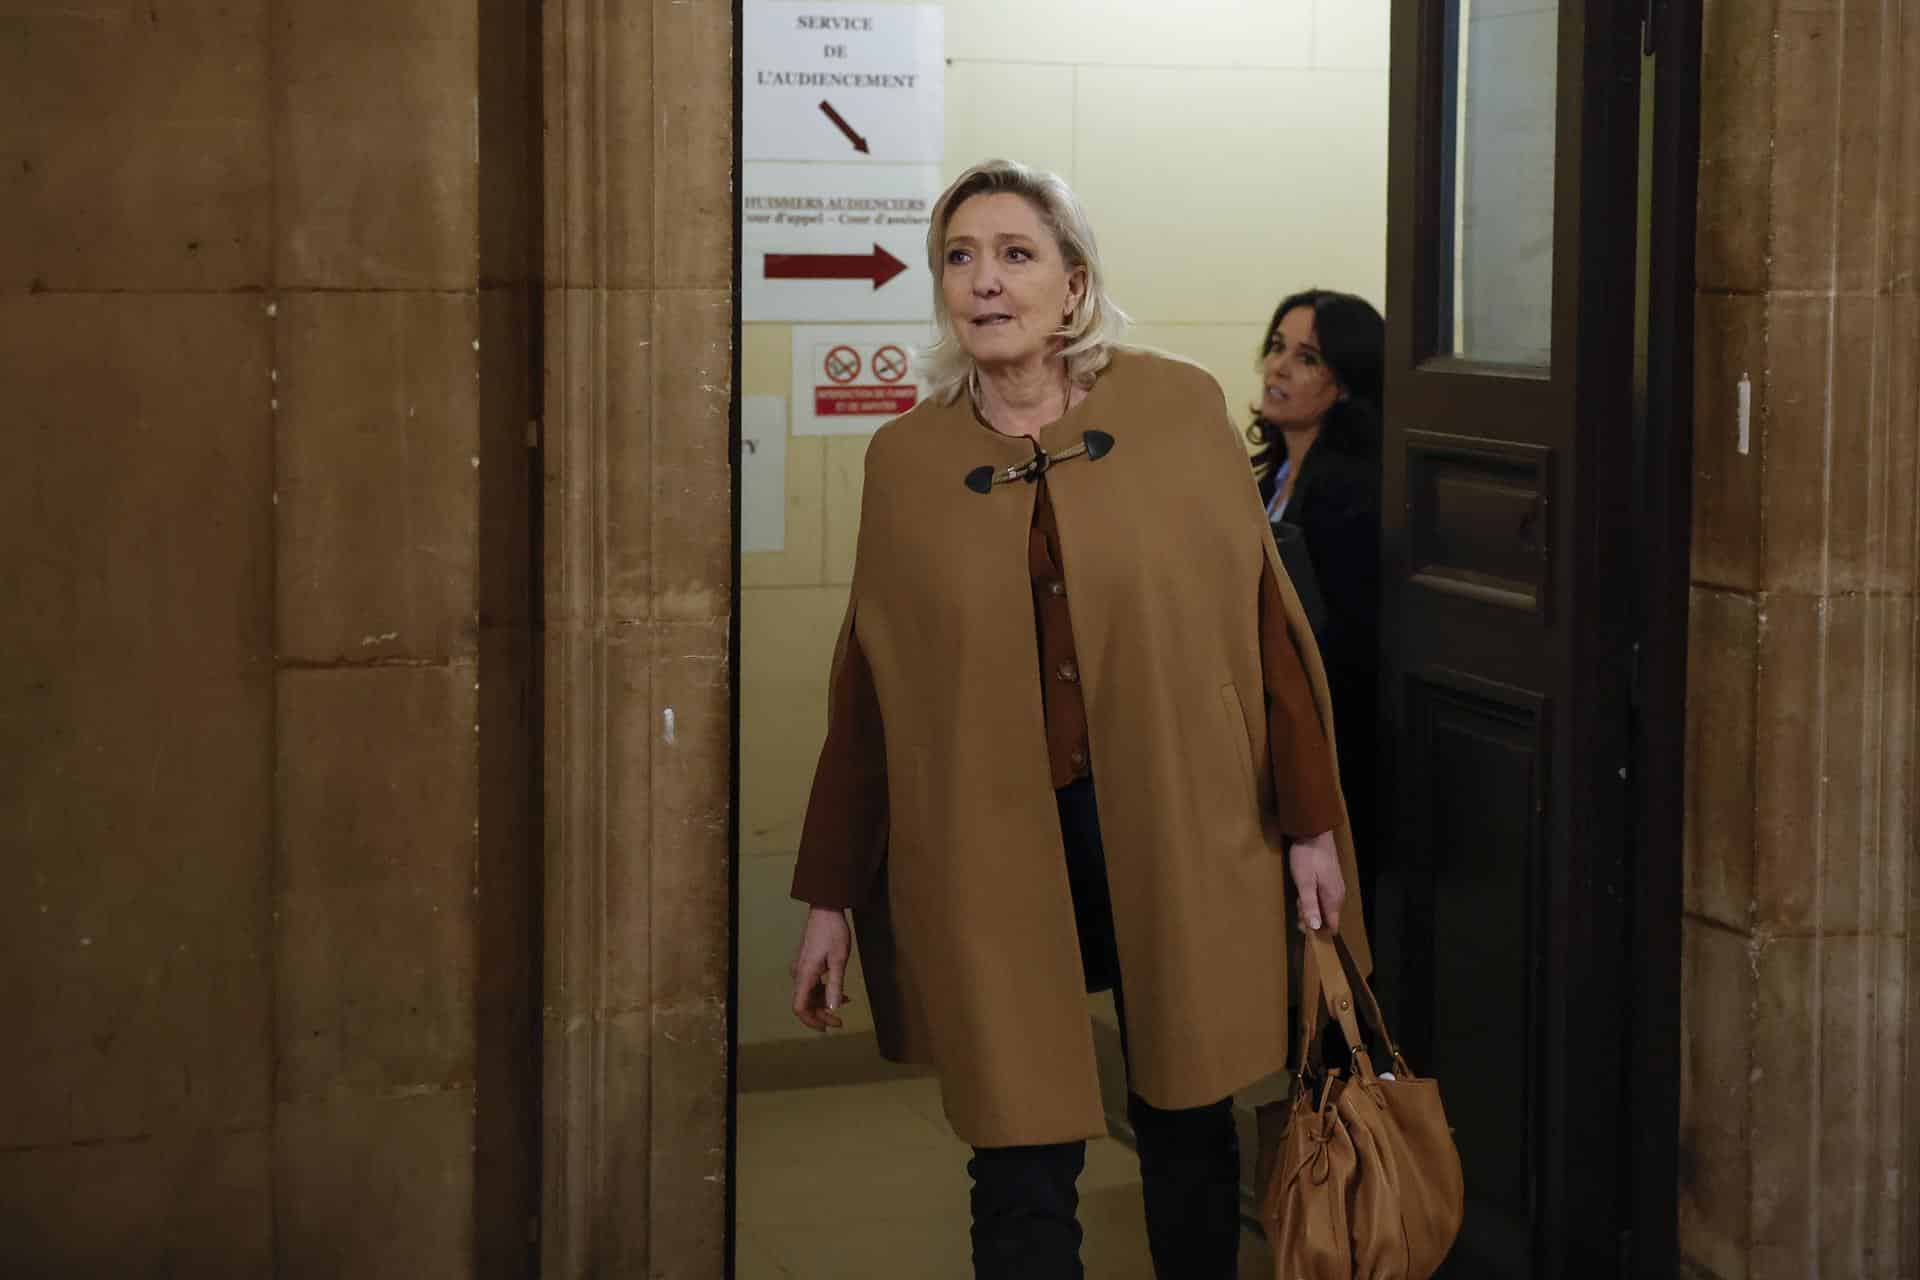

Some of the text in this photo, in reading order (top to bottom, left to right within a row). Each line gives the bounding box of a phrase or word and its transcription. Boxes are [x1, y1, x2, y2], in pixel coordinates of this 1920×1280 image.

[796, 15, 873, 31] SERVICE
[823, 44, 848, 60] DE
[757, 70, 916, 89] L'AUDIENCEMENT
